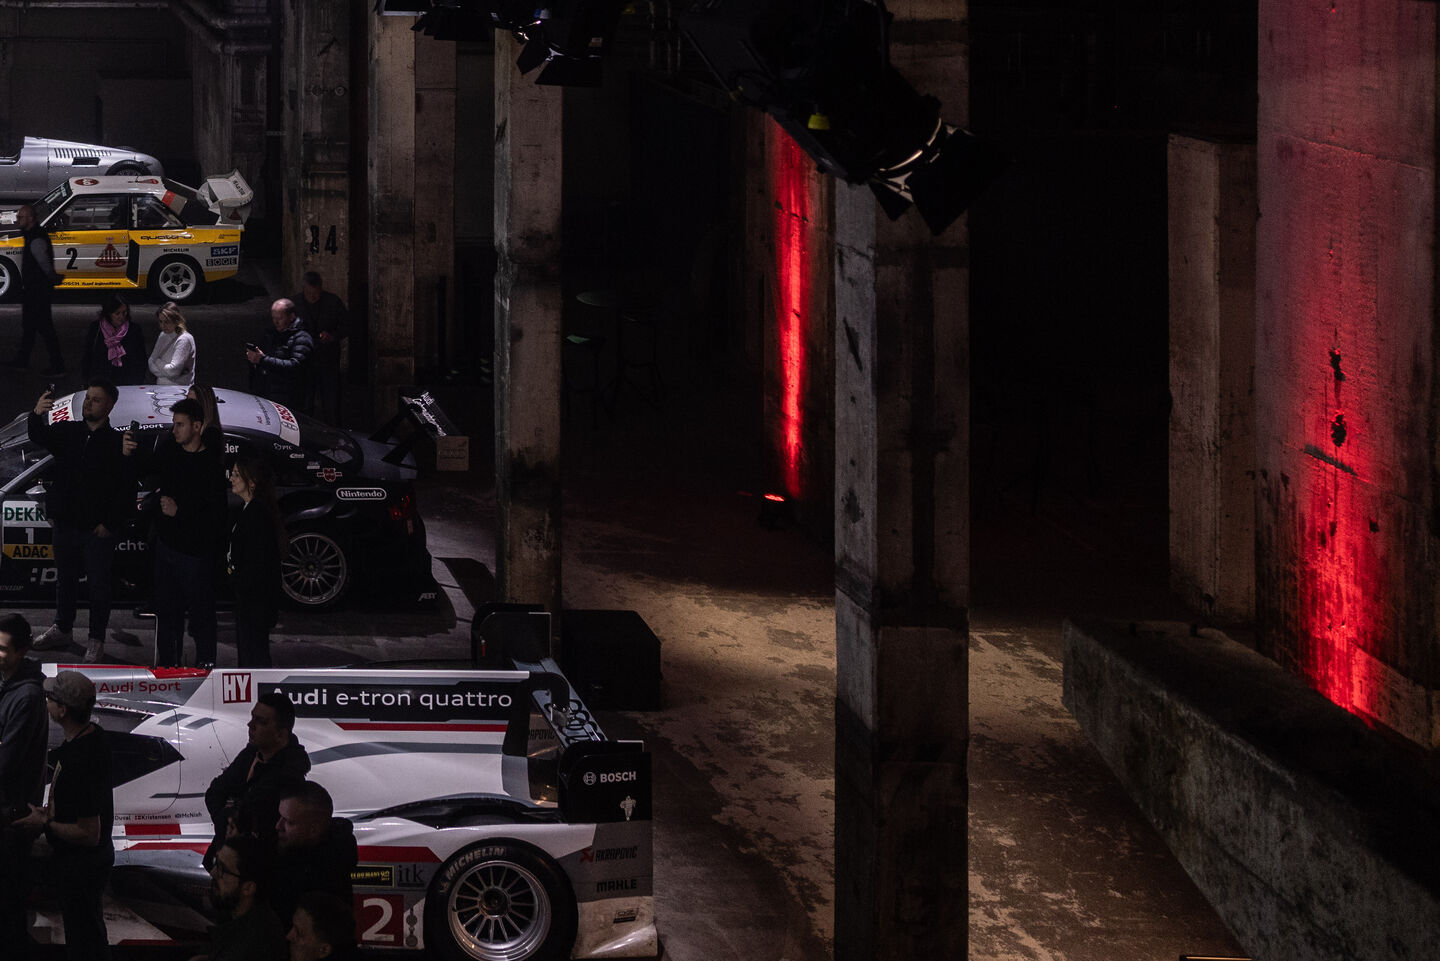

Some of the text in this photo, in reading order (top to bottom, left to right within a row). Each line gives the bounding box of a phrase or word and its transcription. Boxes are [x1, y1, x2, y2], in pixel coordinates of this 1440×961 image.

[66, 247, 78, 270] 2
[212, 247, 237, 256] SKF
[340, 489, 384, 498] Nintendo
[25, 527, 35, 544] 1
[12, 545, 49, 558] ADAC
[99, 681, 181, 694] Audi Sport
[223, 674, 250, 702] HY
[336, 690, 411, 706] e-tron
[419, 690, 513, 709] quattro
[600, 770, 637, 784] BOSCH
[445, 847, 505, 881] MICHELIN
[597, 878, 637, 892] MAHLE
[361, 897, 395, 942] 2
